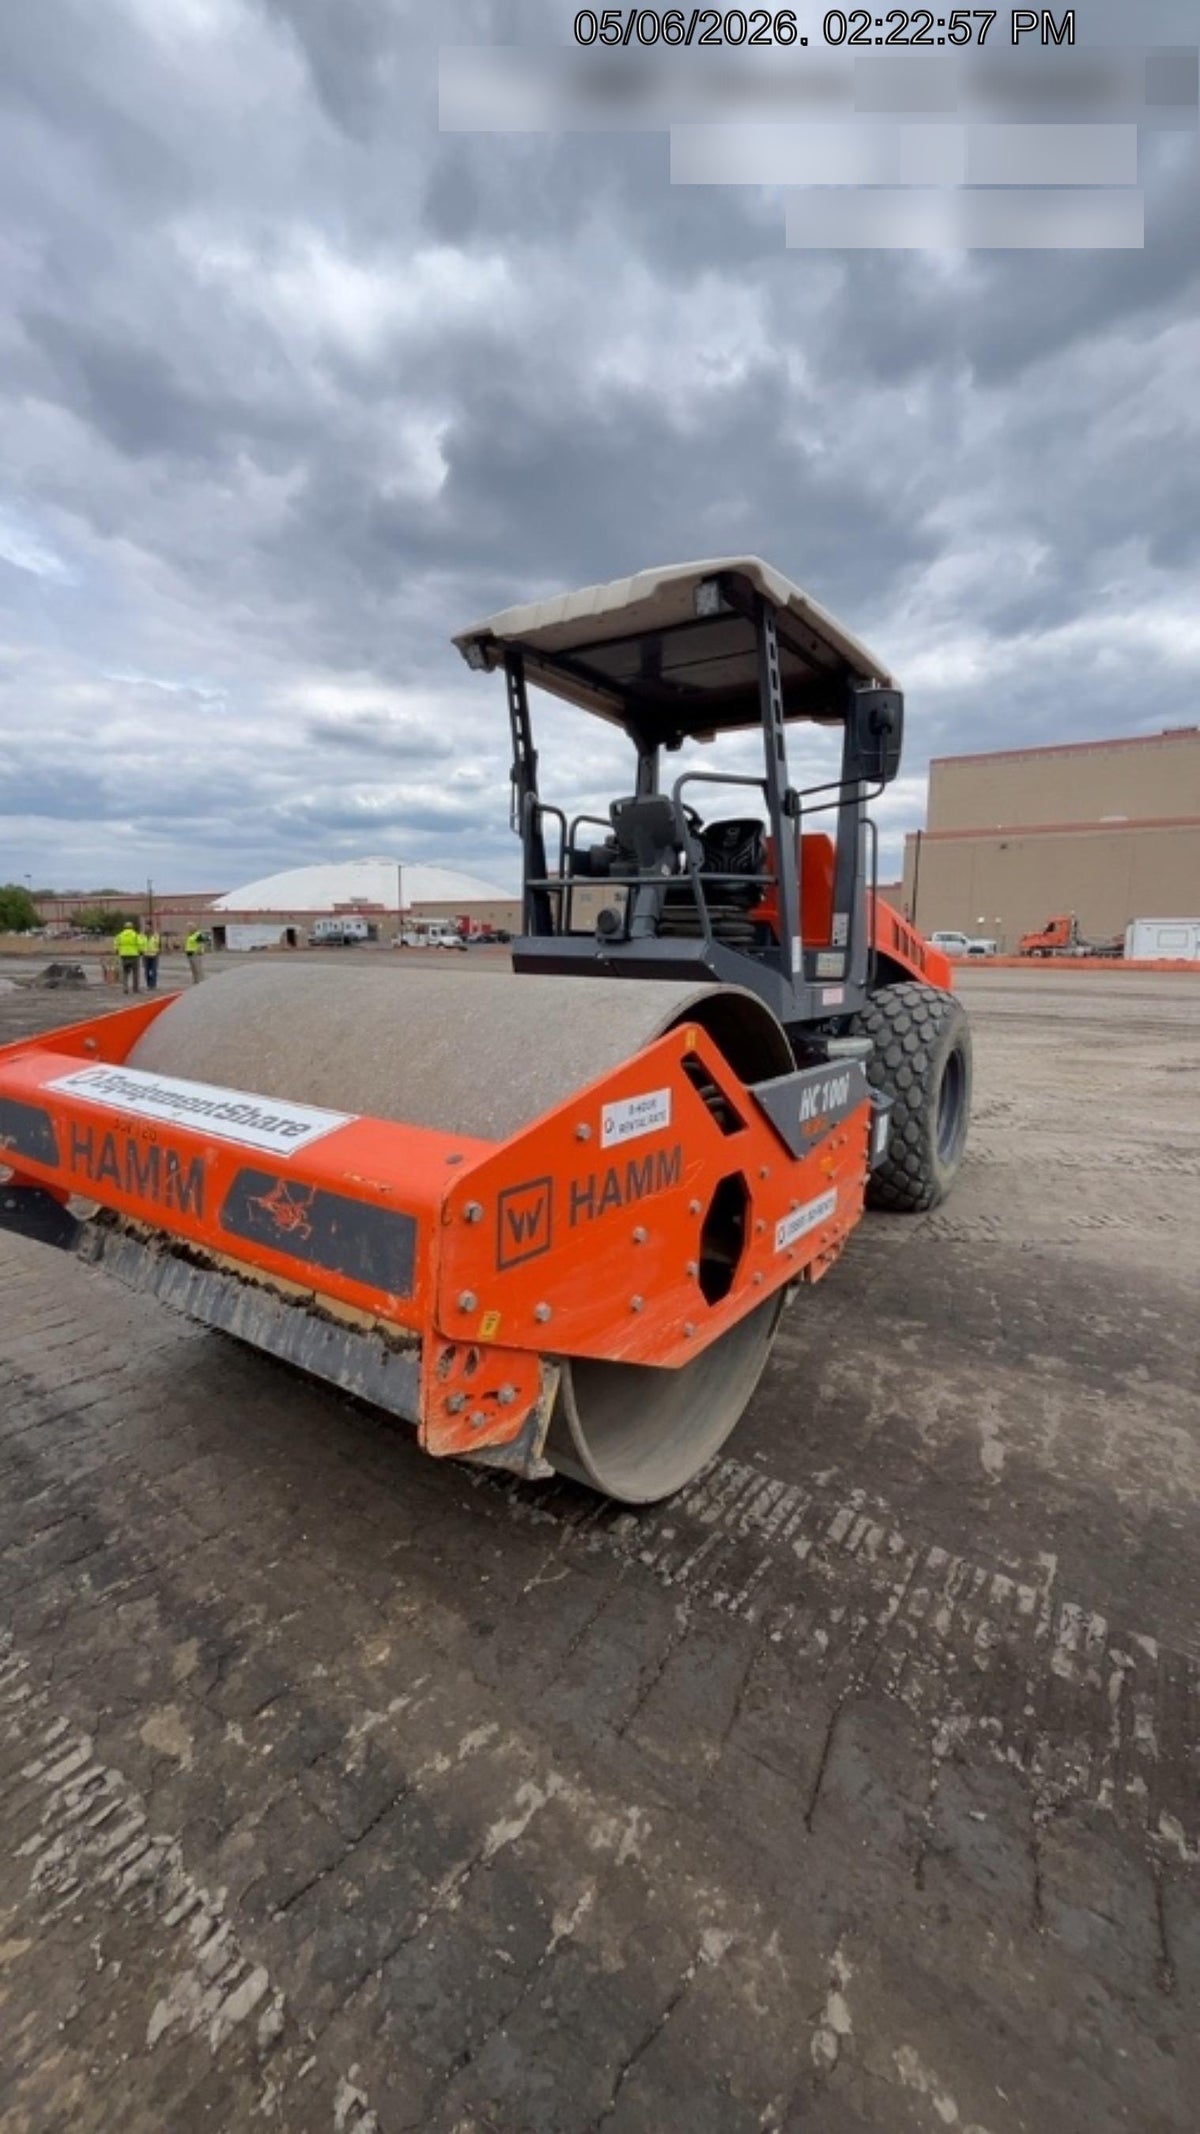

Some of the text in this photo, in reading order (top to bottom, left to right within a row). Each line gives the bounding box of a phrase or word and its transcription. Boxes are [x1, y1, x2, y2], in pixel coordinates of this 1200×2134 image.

[98, 1074, 312, 1138] EquipmentShare
[799, 1083, 821, 1122] HC
[69, 1120, 207, 1220] HAMM
[569, 1144, 683, 1227] HAMM
